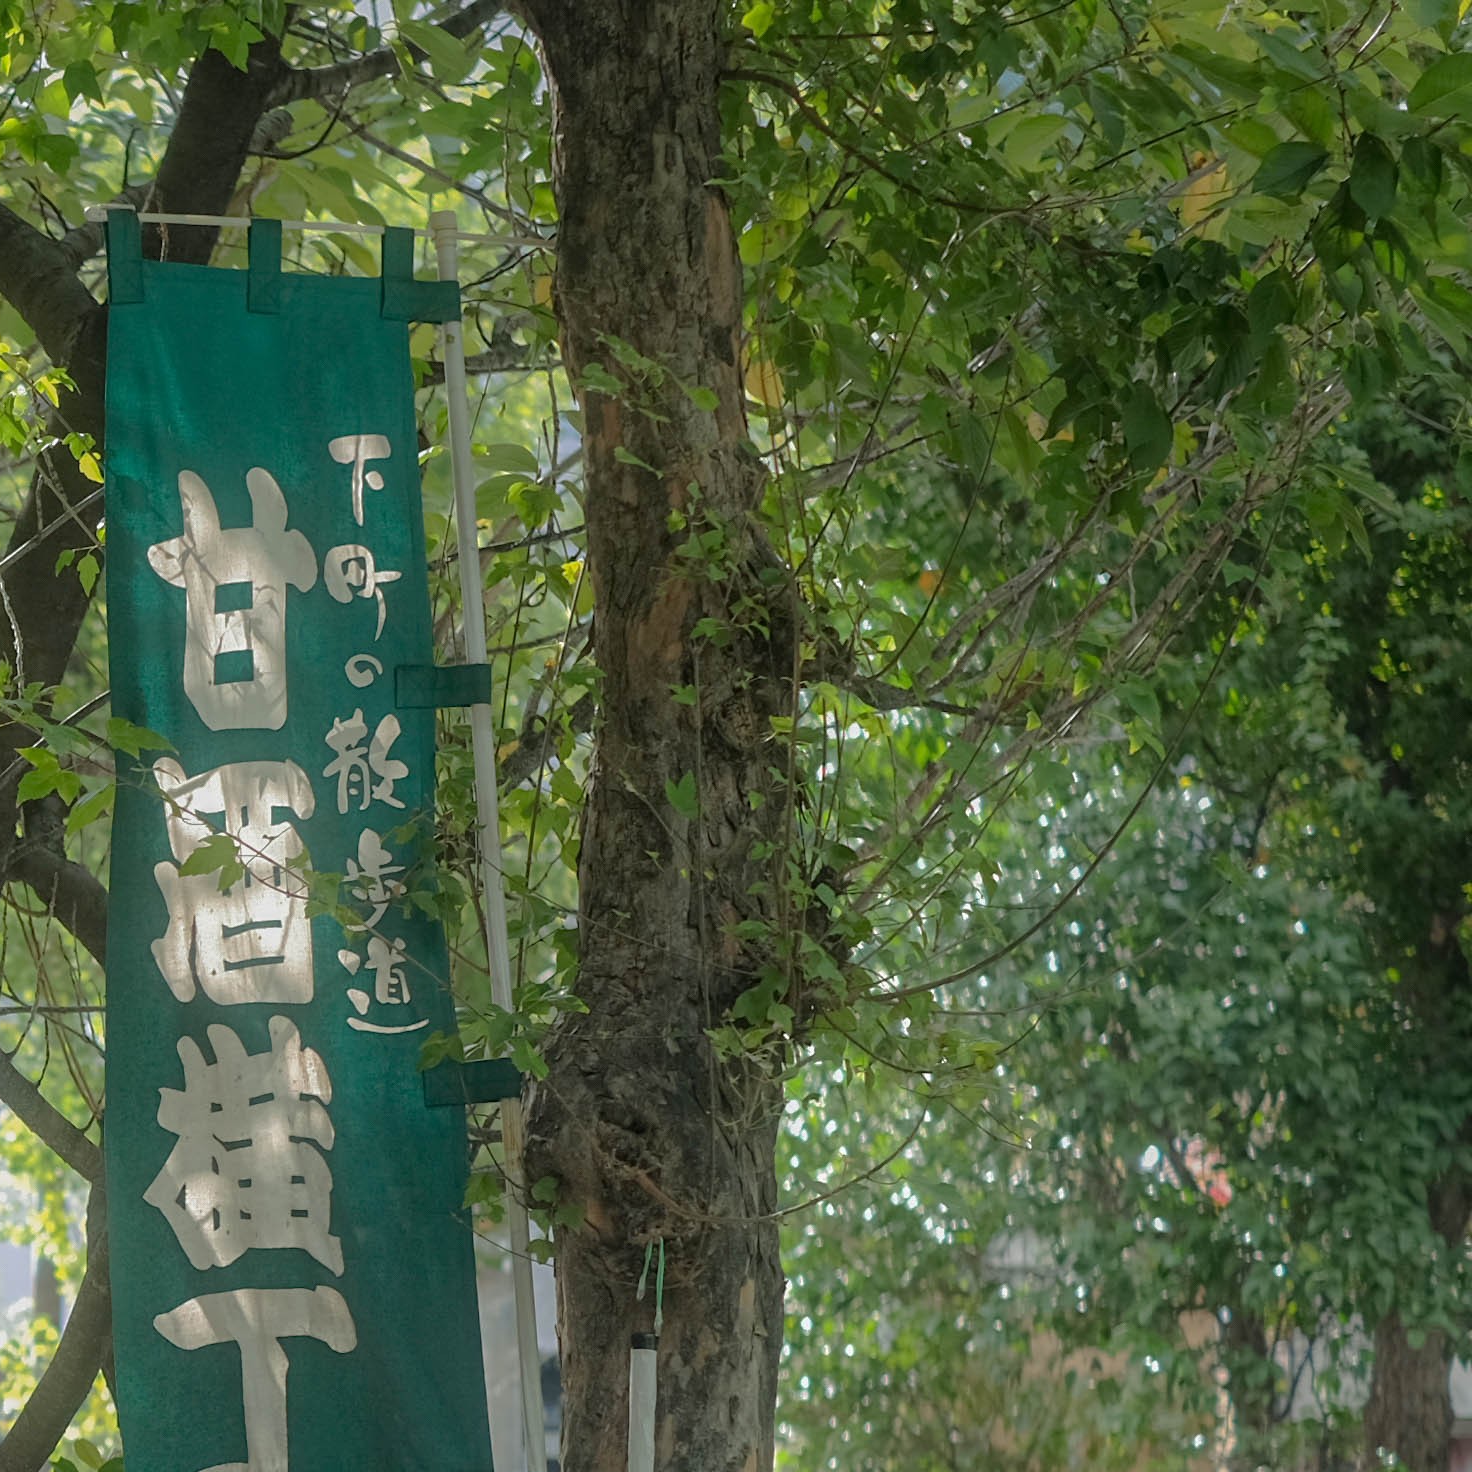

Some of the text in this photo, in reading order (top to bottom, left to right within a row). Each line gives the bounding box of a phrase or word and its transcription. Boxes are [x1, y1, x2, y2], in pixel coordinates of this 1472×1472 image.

[322, 434, 430, 1035] 下町の散歩道
